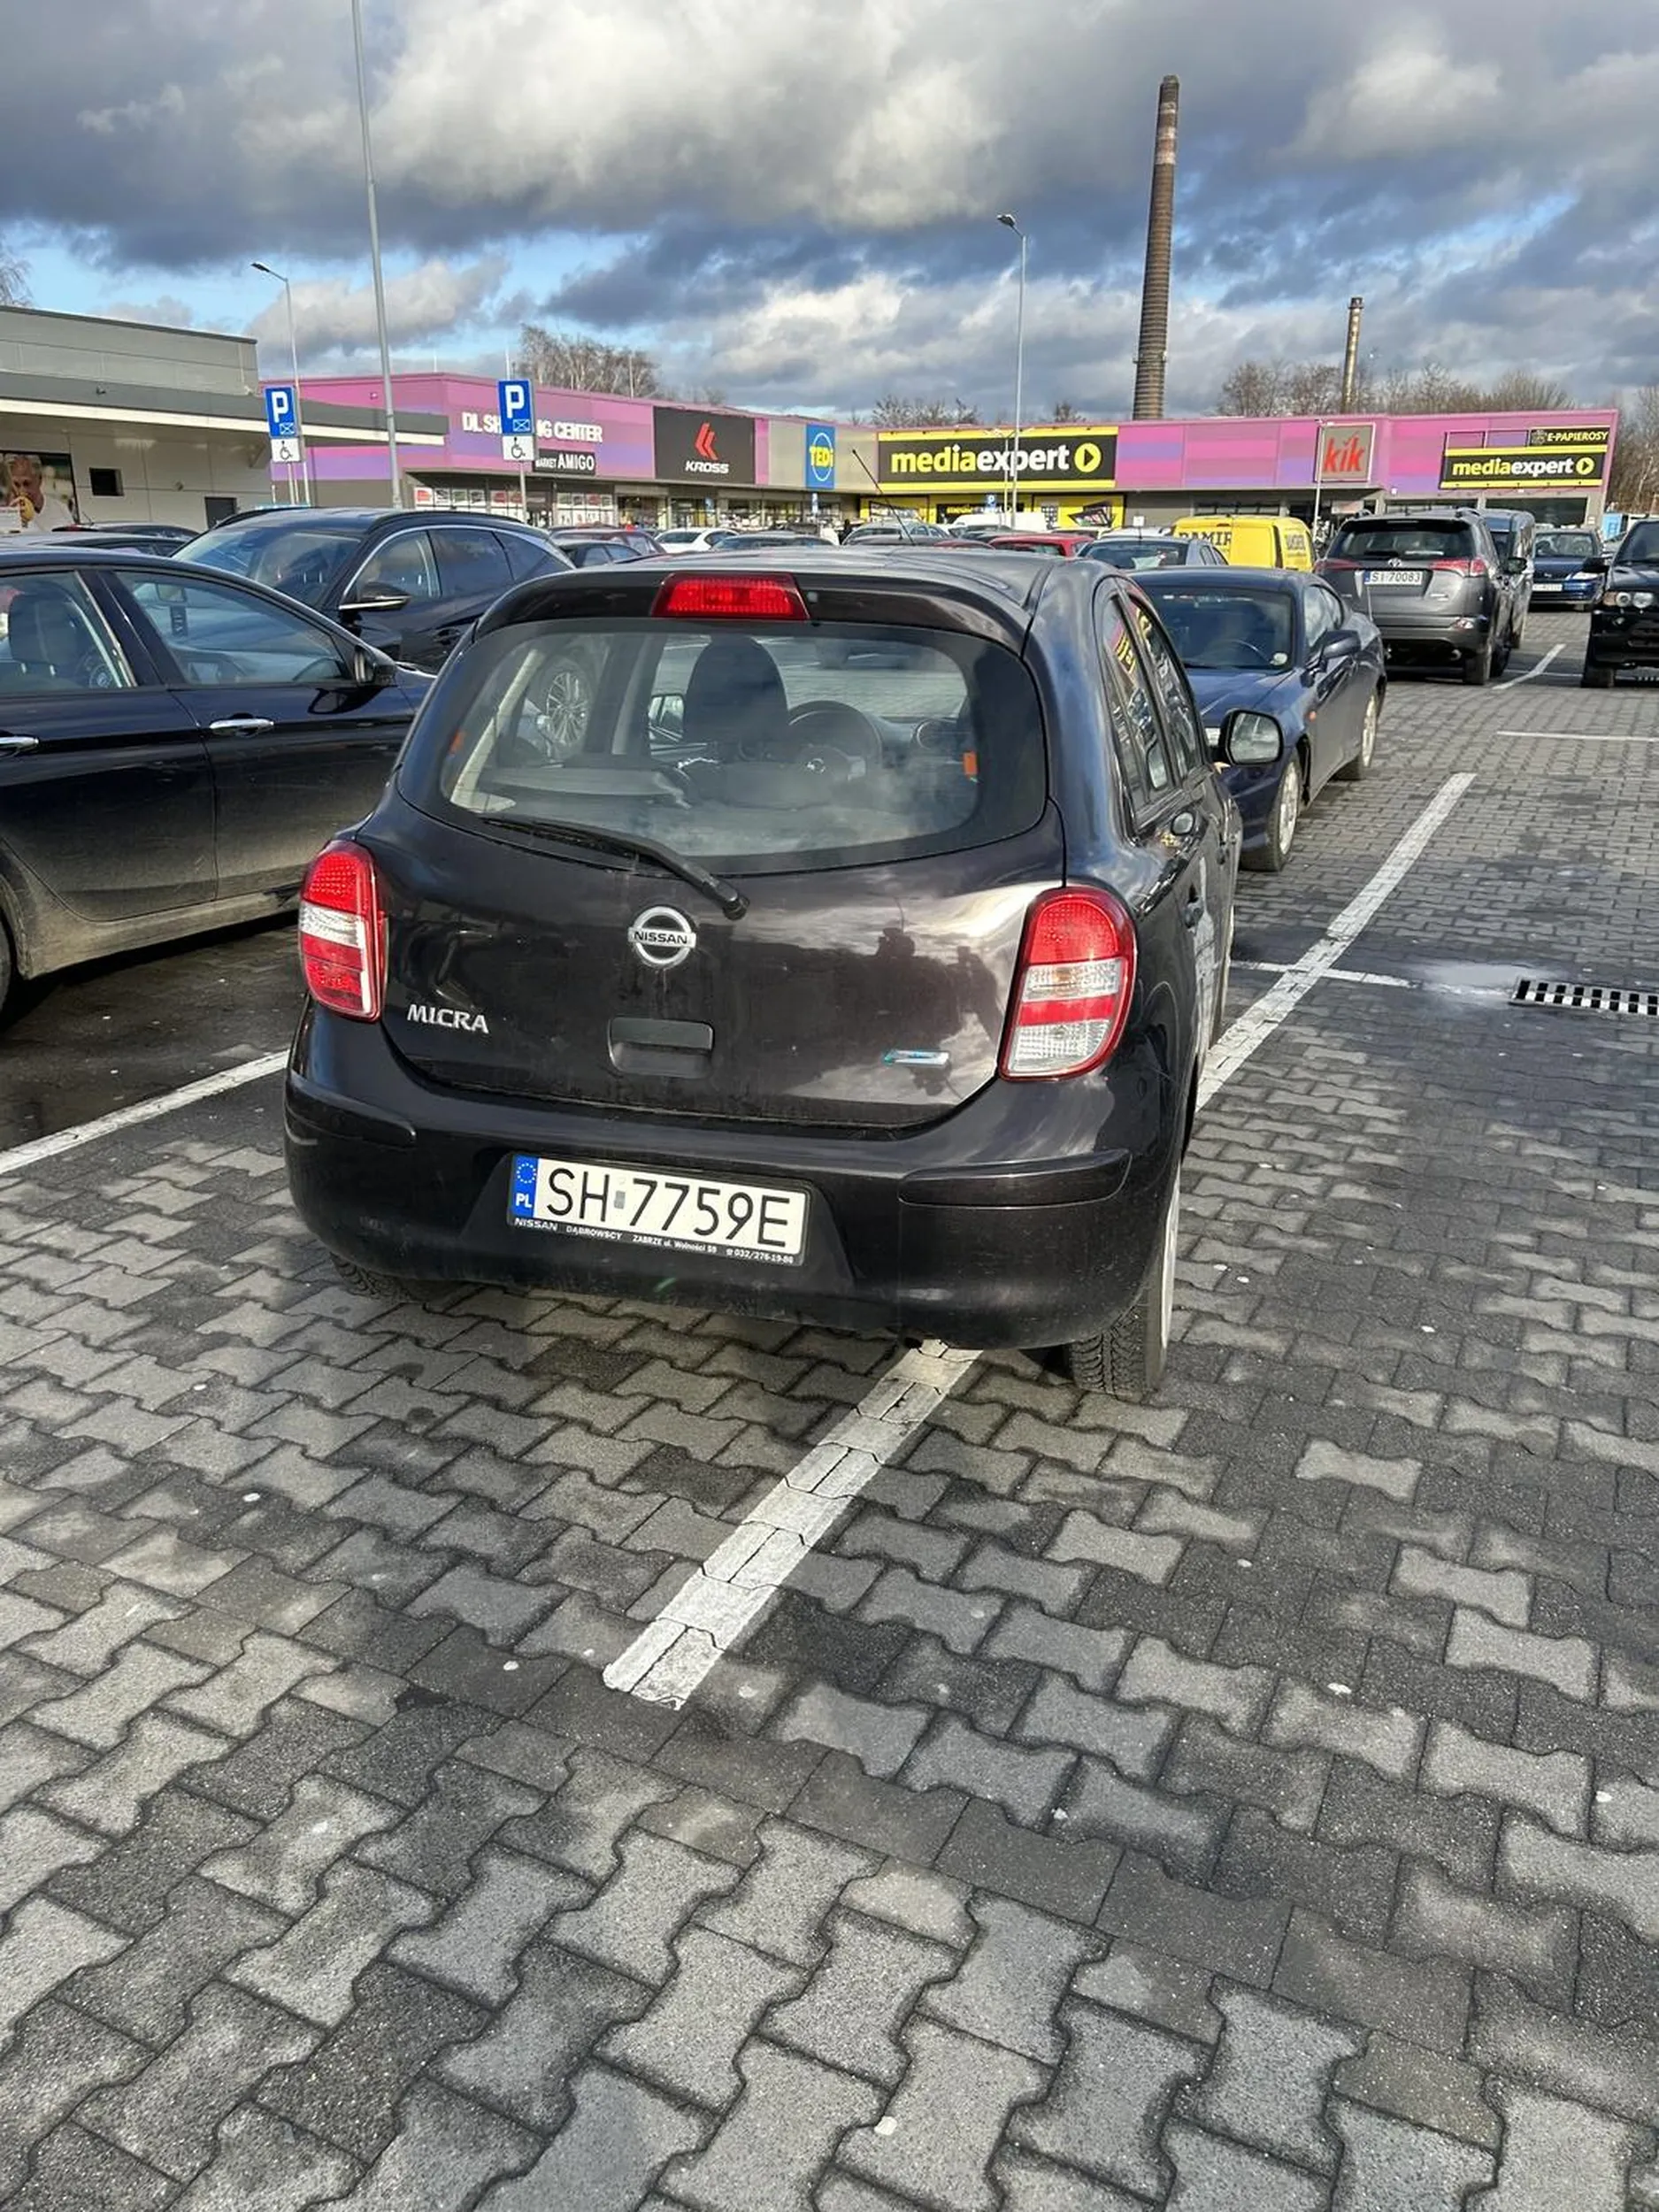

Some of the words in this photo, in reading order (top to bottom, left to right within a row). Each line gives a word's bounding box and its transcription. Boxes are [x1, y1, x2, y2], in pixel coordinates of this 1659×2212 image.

[272, 391, 289, 423] P
[505, 385, 525, 419] P
[462, 412, 482, 433] DL
[554, 422, 603, 442] CENTER
[1547, 431, 1609, 442] E-PAPIEROSY
[557, 453, 595, 471] AMIGO
[890, 443, 1070, 478] mediaexpert
[1324, 431, 1364, 472] kik
[685, 460, 730, 474] KROSS
[1452, 457, 1575, 478] mediaexpert
[634, 931, 688, 945] NISSAN
[406, 1003, 489, 1034] MICRA
[515, 1194, 533, 1209] PL
[546, 1167, 610, 1223] SH
[628, 1178, 790, 1248] 7759E
[514, 1217, 558, 1232] NISSAN
[633, 1234, 662, 1247] ZABRZE
